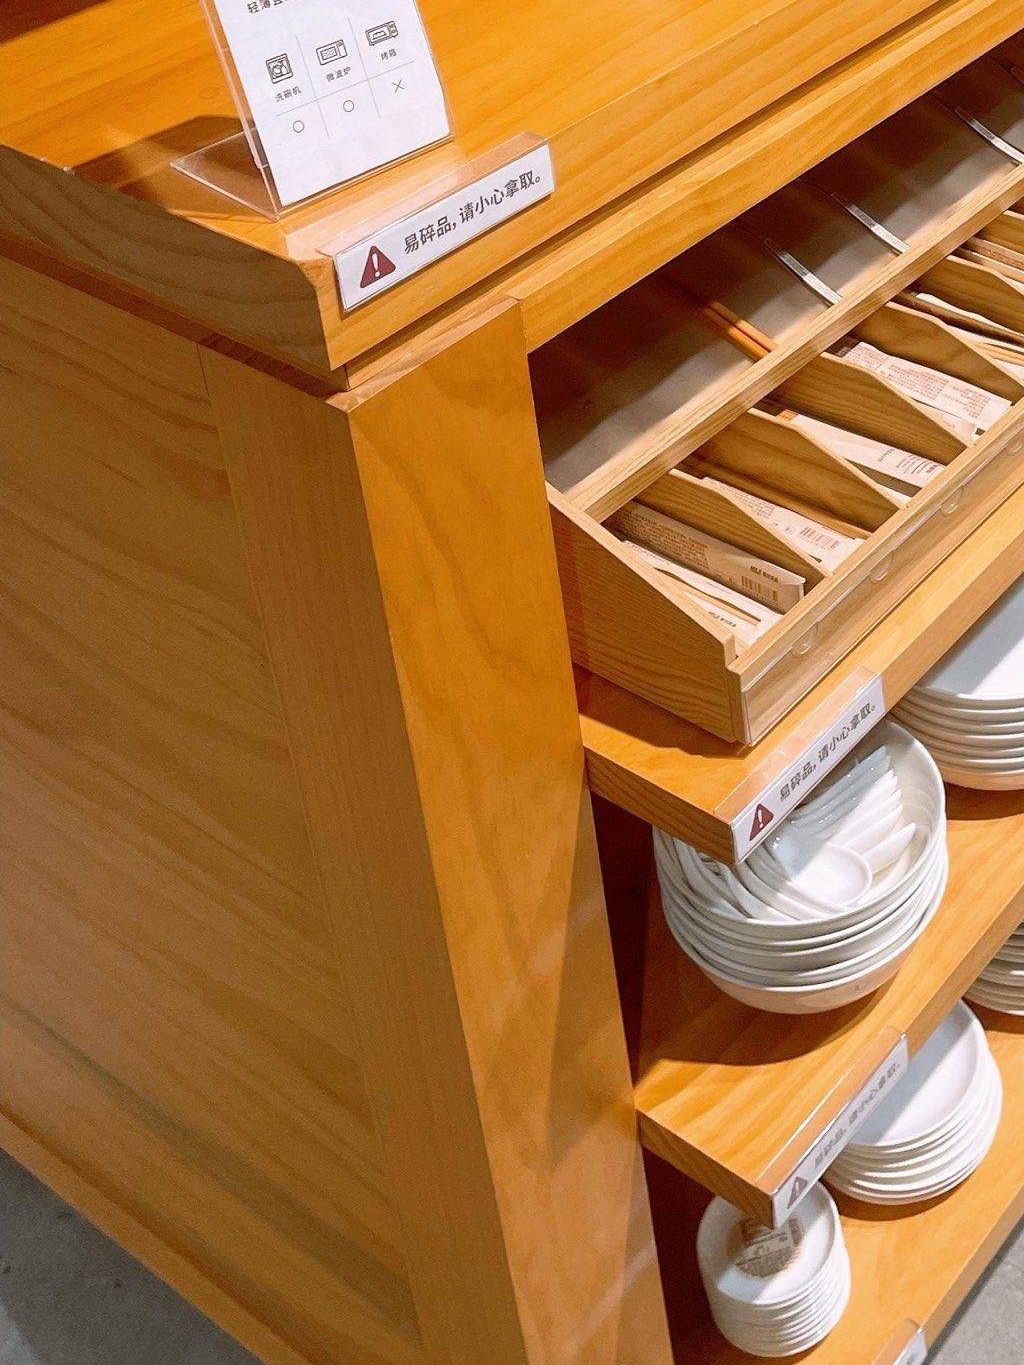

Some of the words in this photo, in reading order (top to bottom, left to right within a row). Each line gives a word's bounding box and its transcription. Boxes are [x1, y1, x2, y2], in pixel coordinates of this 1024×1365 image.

[380, 48, 397, 62] 烤箱
[326, 66, 352, 83] 微波炉
[274, 86, 302, 103] 洗碗机
